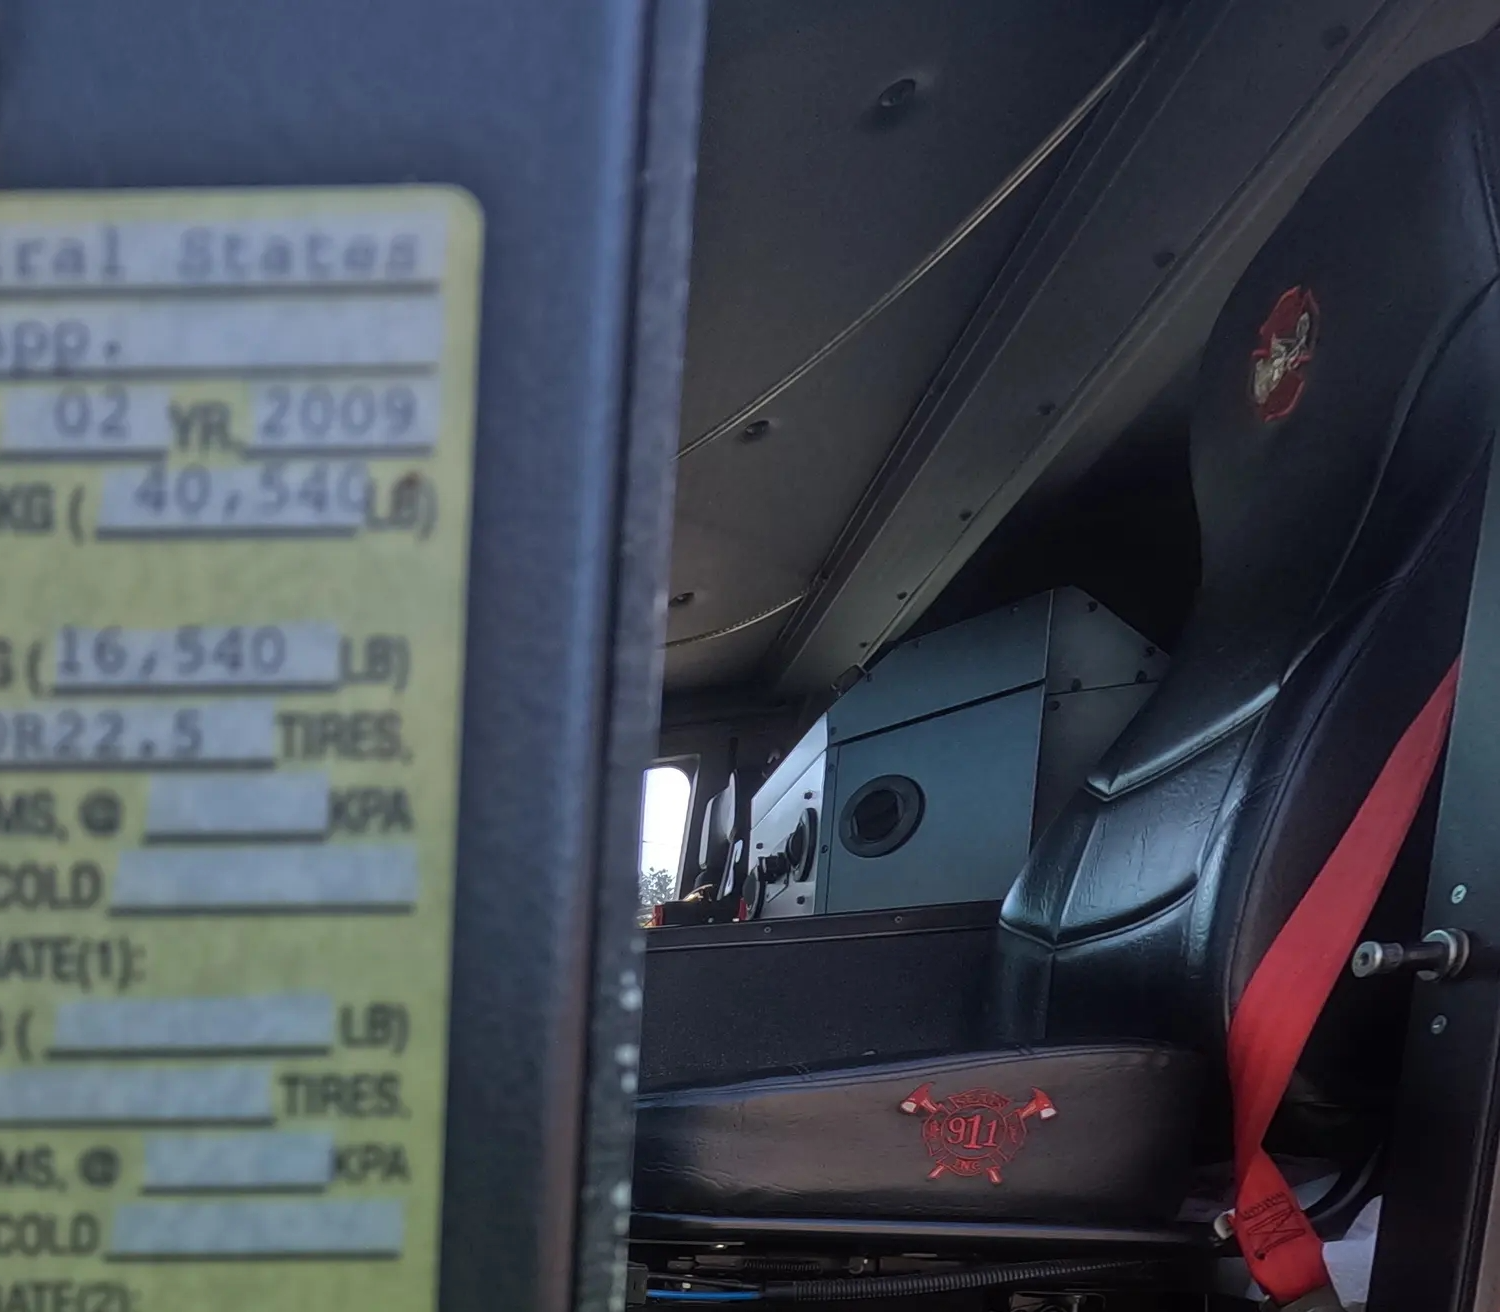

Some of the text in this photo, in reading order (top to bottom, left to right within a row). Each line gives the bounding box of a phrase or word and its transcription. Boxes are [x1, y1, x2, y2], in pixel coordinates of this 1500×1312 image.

[177, 226, 420, 281] States
[55, 384, 130, 438] 02
[259, 384, 419, 438] 2009
[135, 459, 372, 520] 40,540
[58, 623, 288, 677] 16,540
[329, 785, 416, 836] KPA
[947, 1114, 998, 1150] 911
[332, 1143, 412, 1184] KPA
